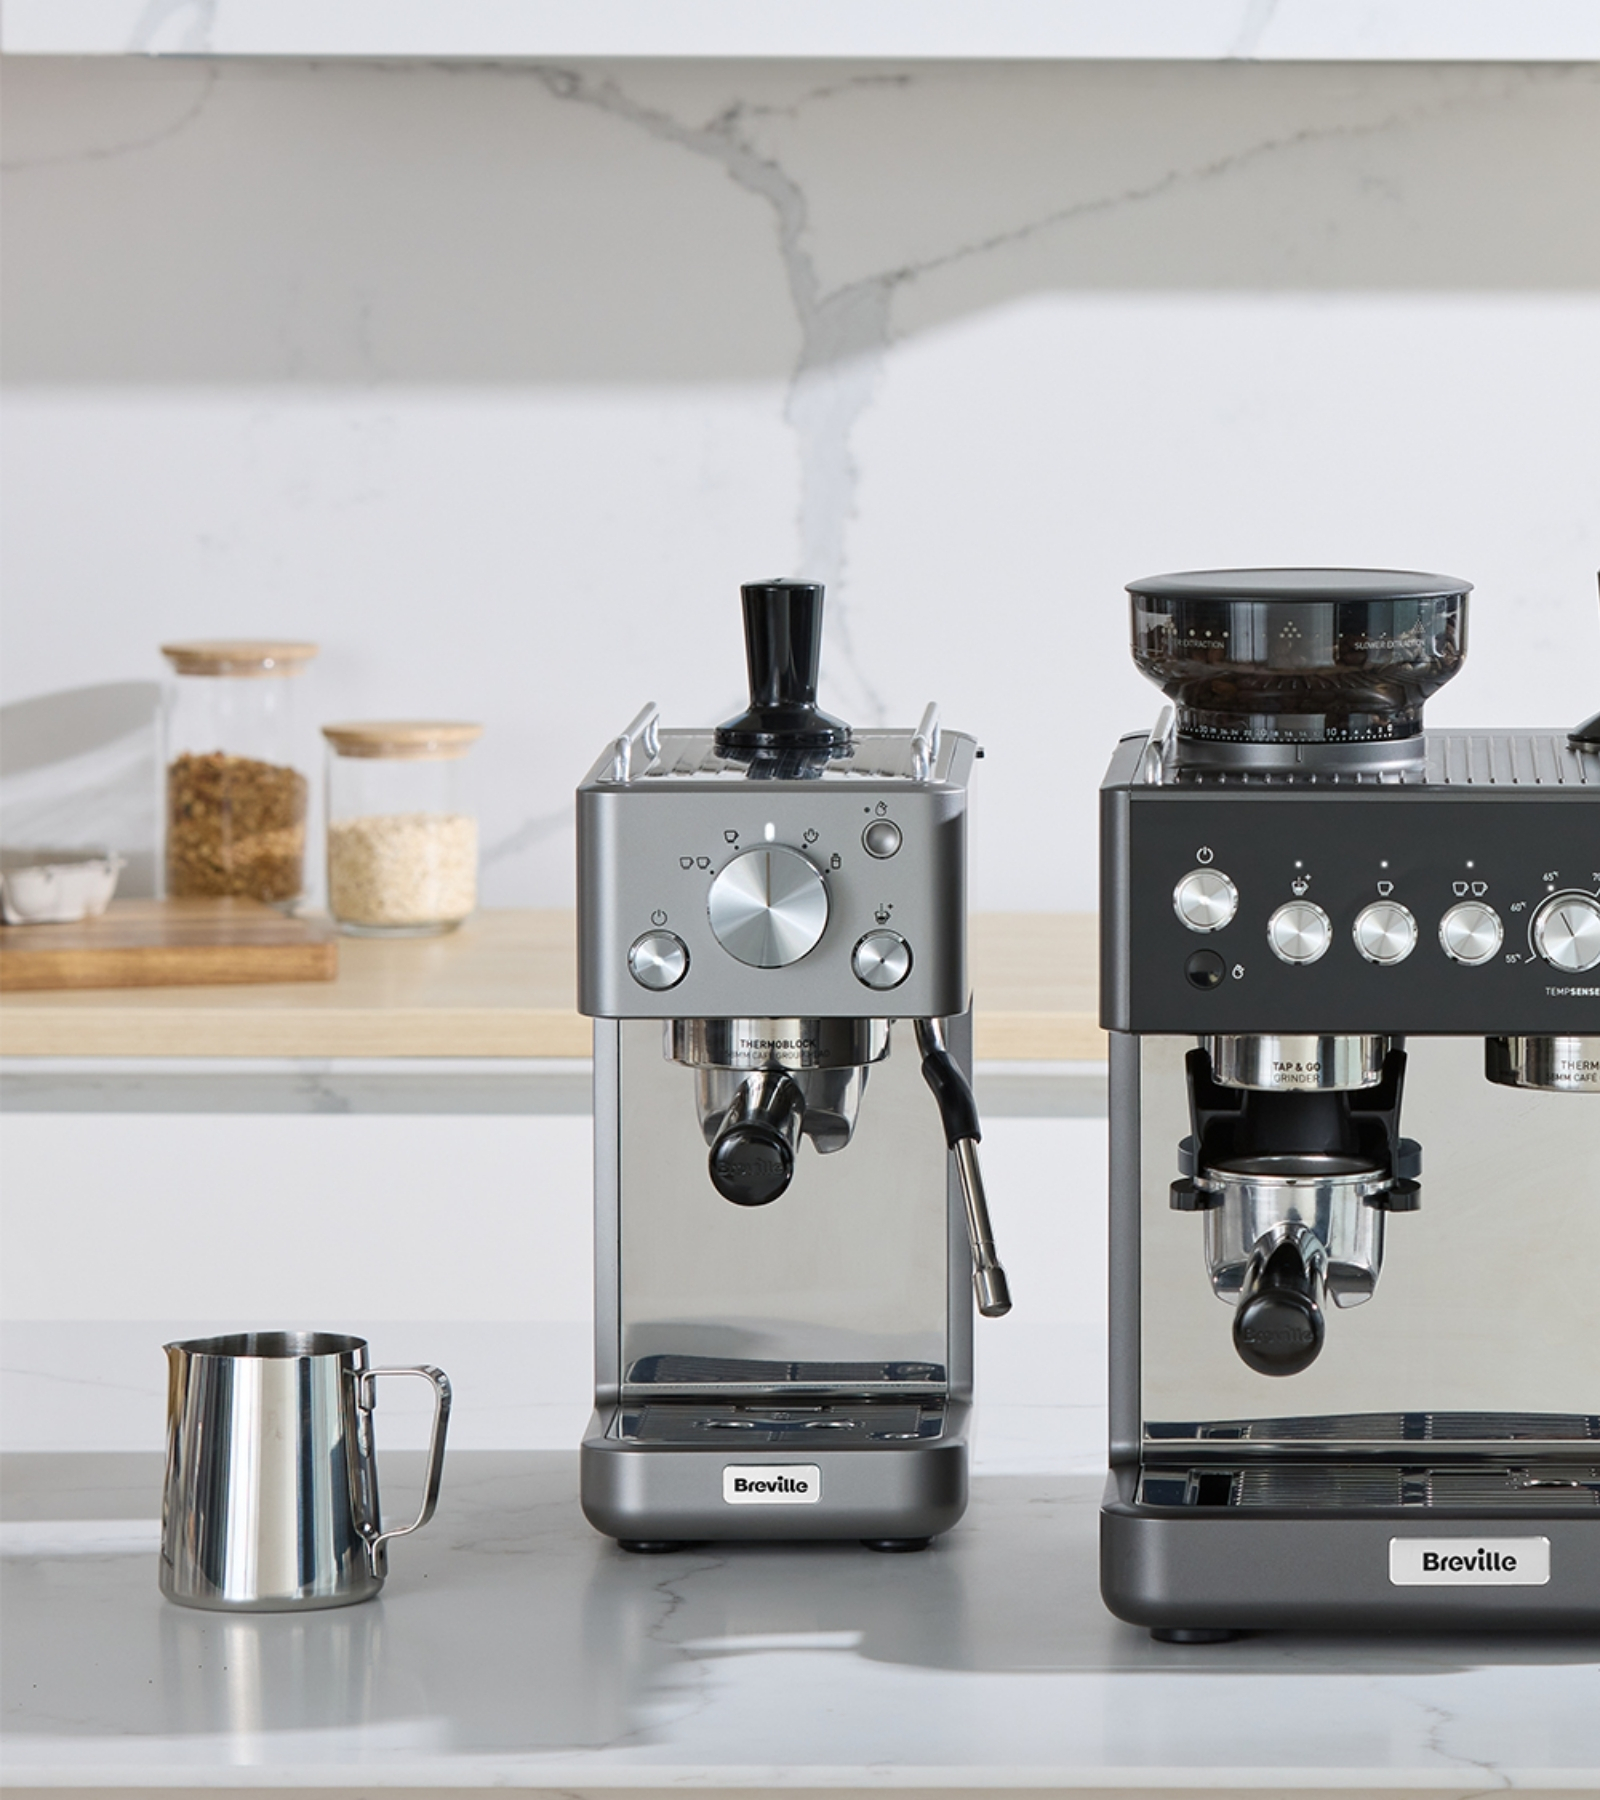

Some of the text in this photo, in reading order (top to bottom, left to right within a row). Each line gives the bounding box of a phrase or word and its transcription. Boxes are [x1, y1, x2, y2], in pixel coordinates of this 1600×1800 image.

[1354, 641, 1386, 650] SLOWER
[1326, 726, 1337, 736] 10
[1545, 987, 1600, 997] TEMPSENSE
[740, 1039, 817, 1049] THERMOBLOCK
[1272, 1062, 1321, 1071] TAP & GO
[1273, 1073, 1320, 1083] GRINDER
[1243, 1323, 1314, 1343] Breville
[734, 1475, 808, 1493] Breville
[1422, 1547, 1517, 1571] Breville
